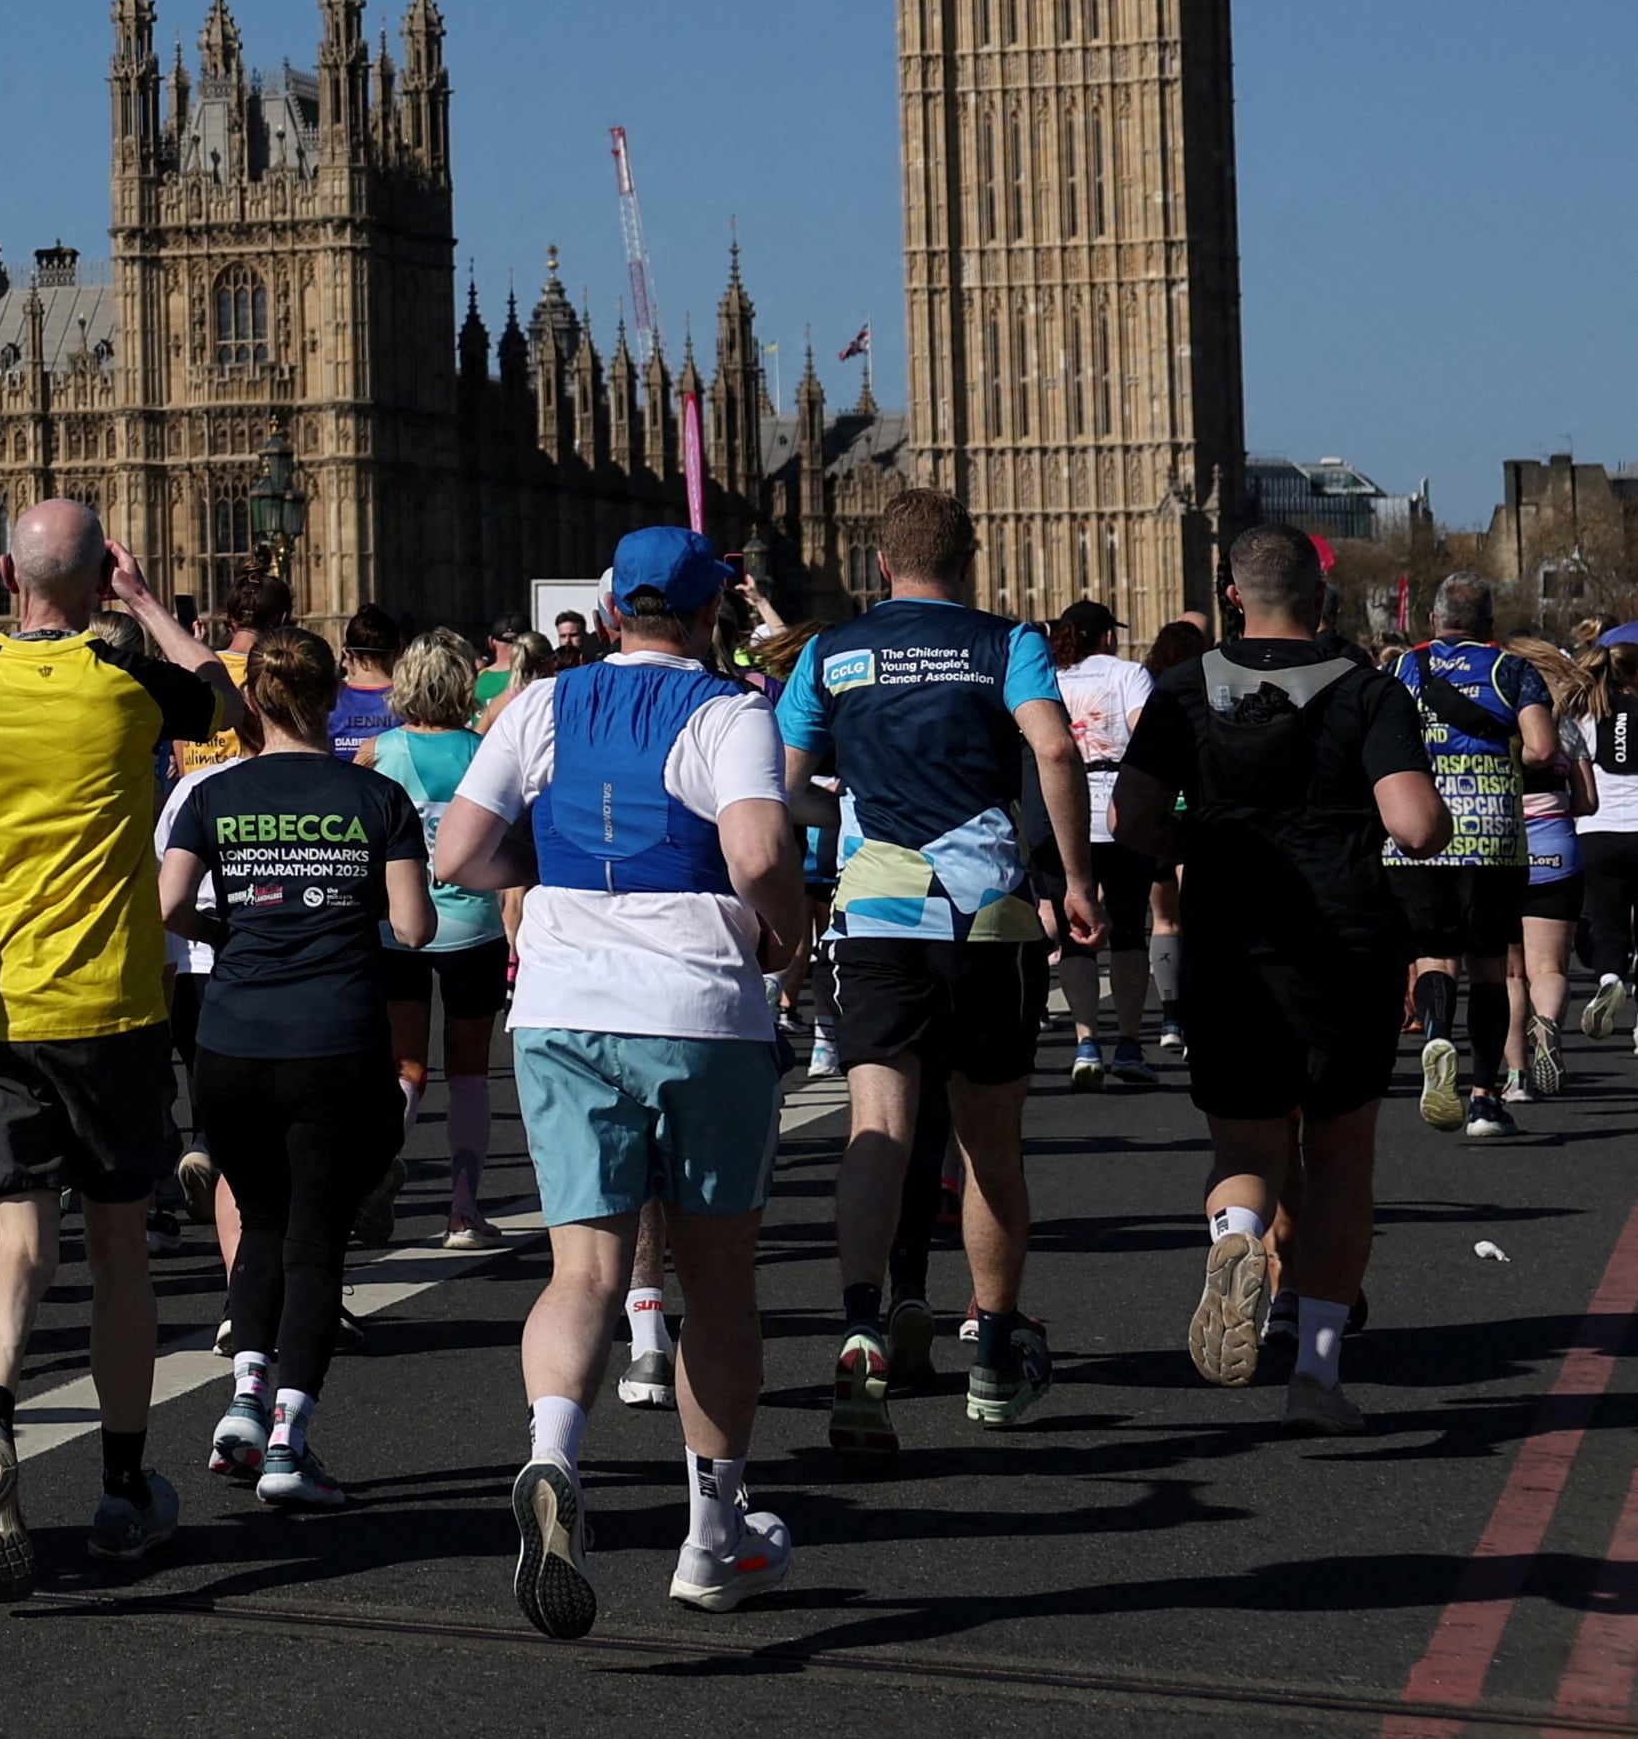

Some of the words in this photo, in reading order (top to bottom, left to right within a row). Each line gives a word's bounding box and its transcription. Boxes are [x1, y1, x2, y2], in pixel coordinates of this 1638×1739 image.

[881, 649, 905, 660] The
[906, 647, 958, 659] Children
[959, 649, 970, 658] &
[830, 663, 865, 680] CCLG
[880, 662, 917, 673] Young
[920, 659, 970, 671] People's
[879, 673, 922, 684] Cancer
[924, 671, 995, 685] Association
[1436, 755, 1496, 775] RSPCA
[603, 781, 613, 843] SALOMON
[216, 814, 370, 844] REBECCA
[219, 848, 279, 861] LONDON
[281, 848, 370, 862] LANDMARKS
[222, 863, 252, 876] HALF
[253, 863, 333, 876] MARATHON
[335, 864, 368, 877] 2025
